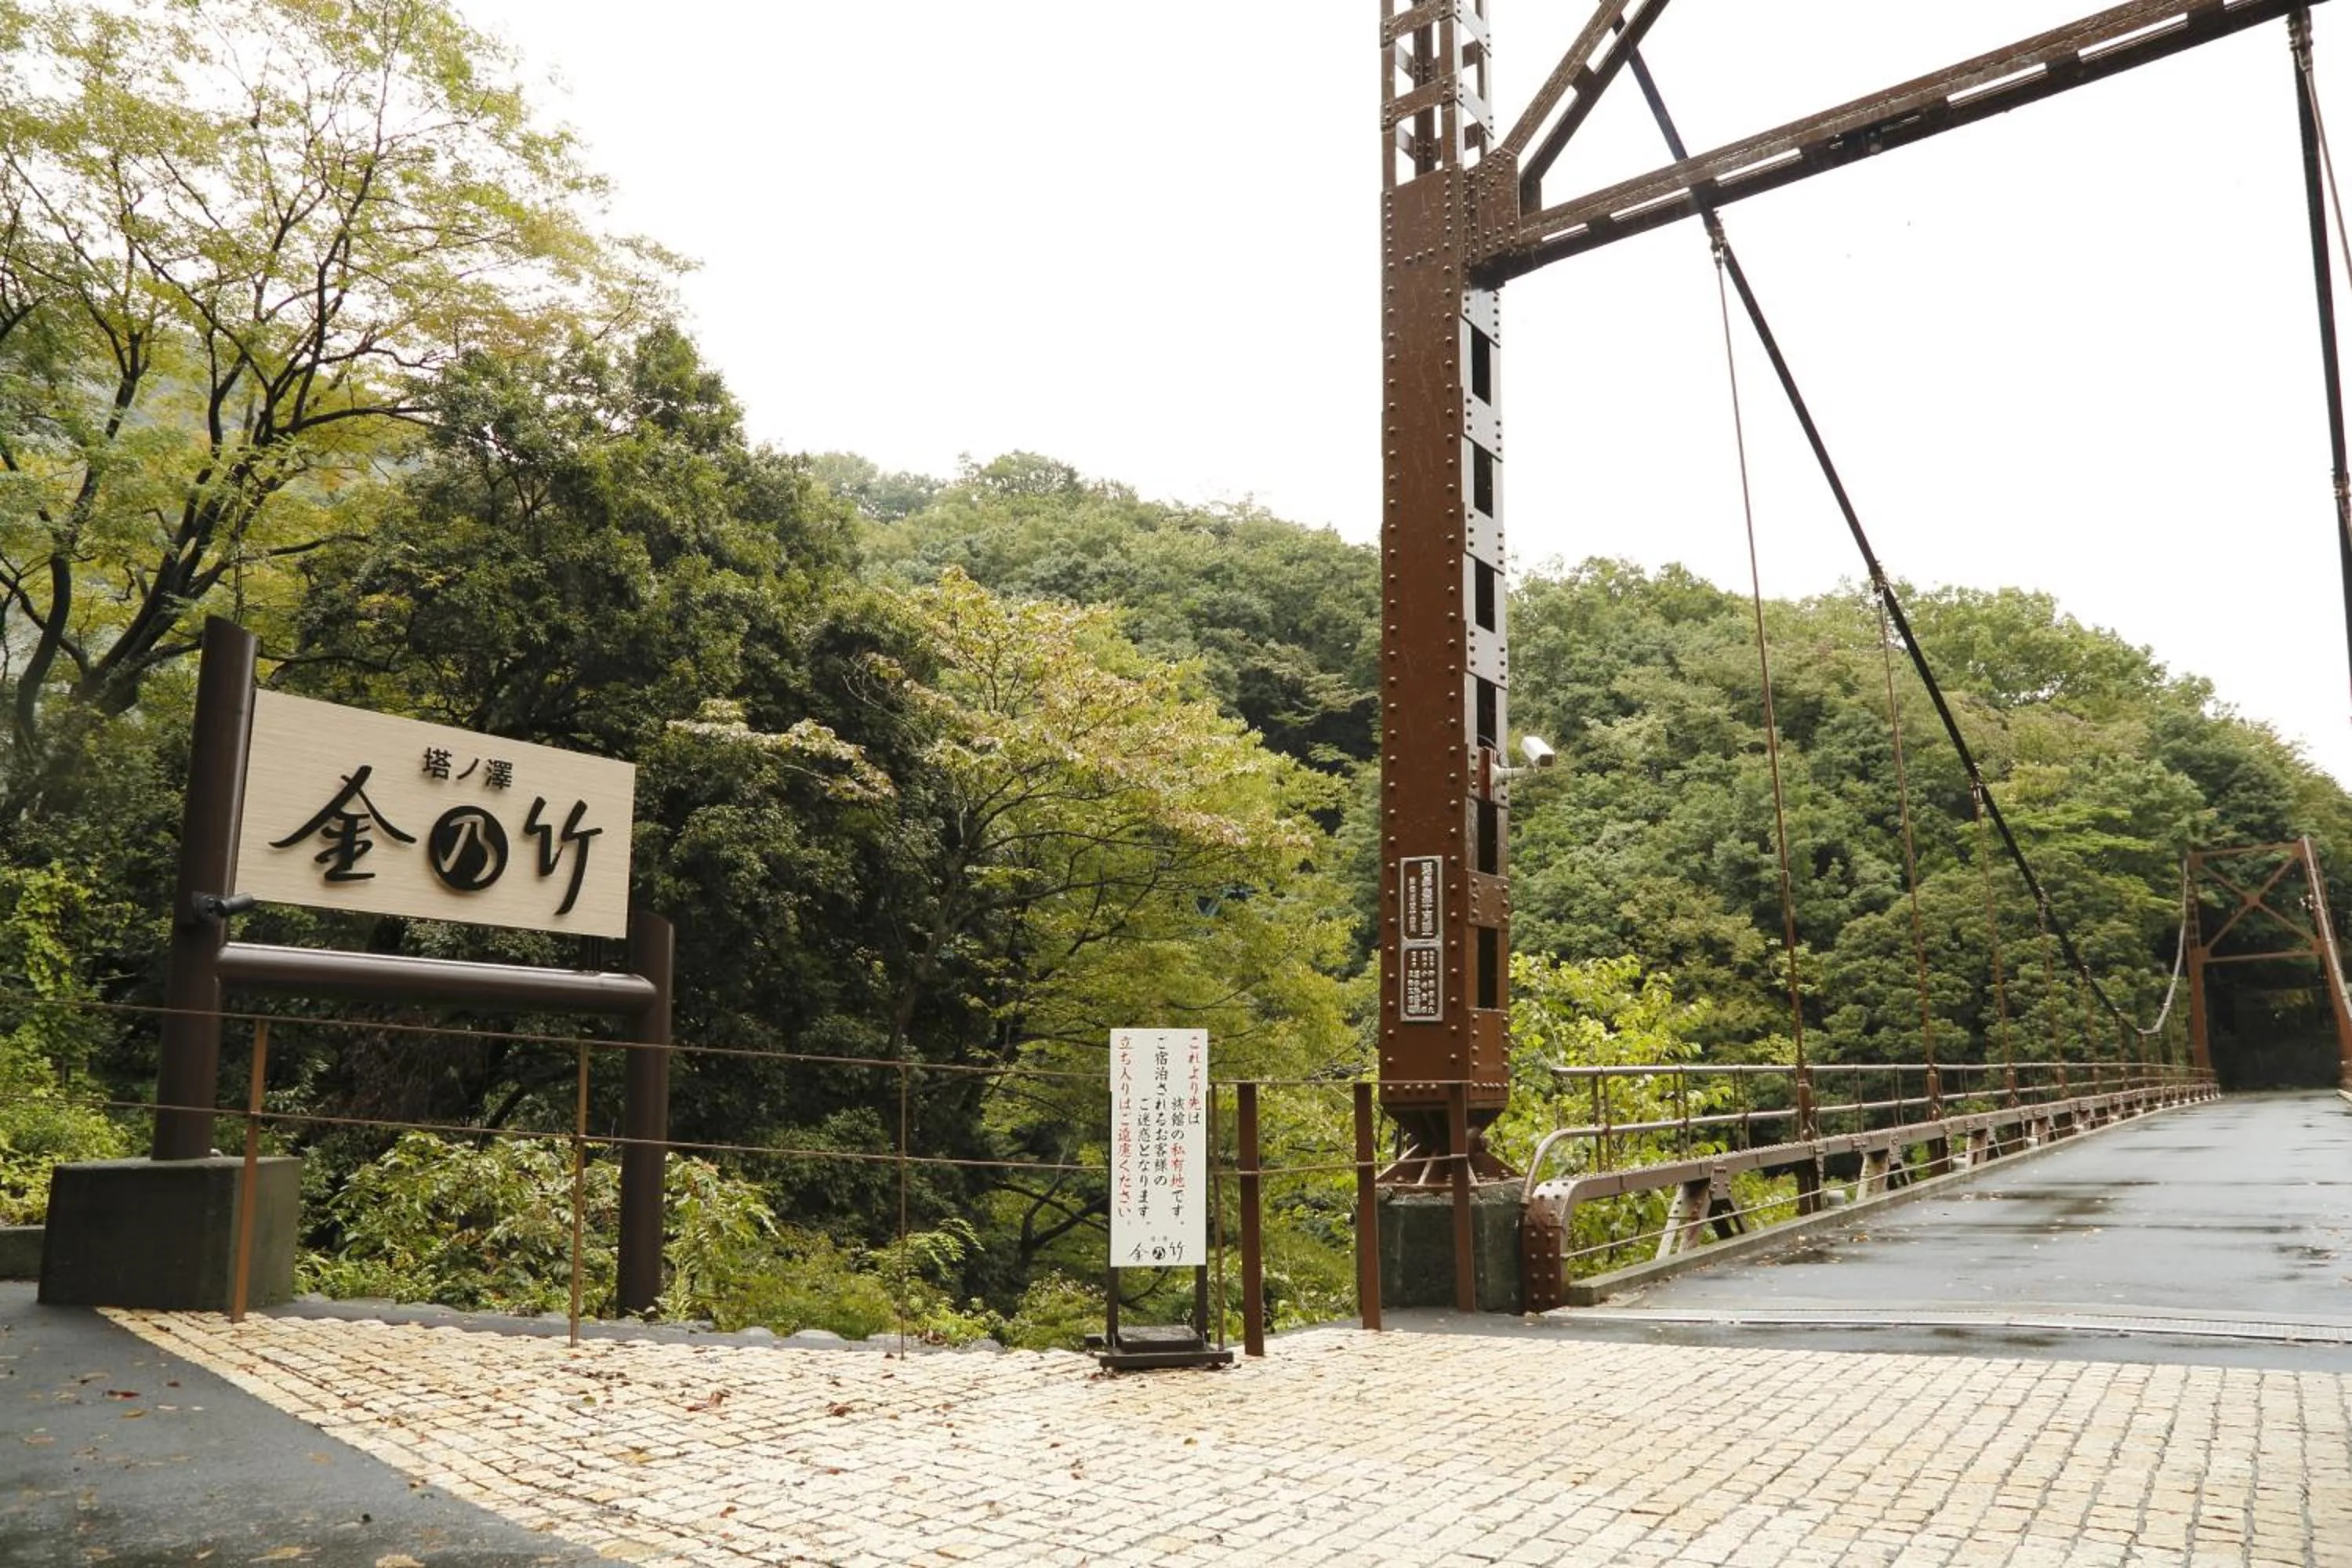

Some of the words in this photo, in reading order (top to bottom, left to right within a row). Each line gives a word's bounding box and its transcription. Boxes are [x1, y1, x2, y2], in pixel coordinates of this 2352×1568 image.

[423, 746, 514, 789] 塔ノ澤
[268, 764, 603, 916] 金乃竹
[1154, 1036, 1168, 1187] ご宿泊されるお客様の
[1188, 1036, 1202, 1125] これより先は
